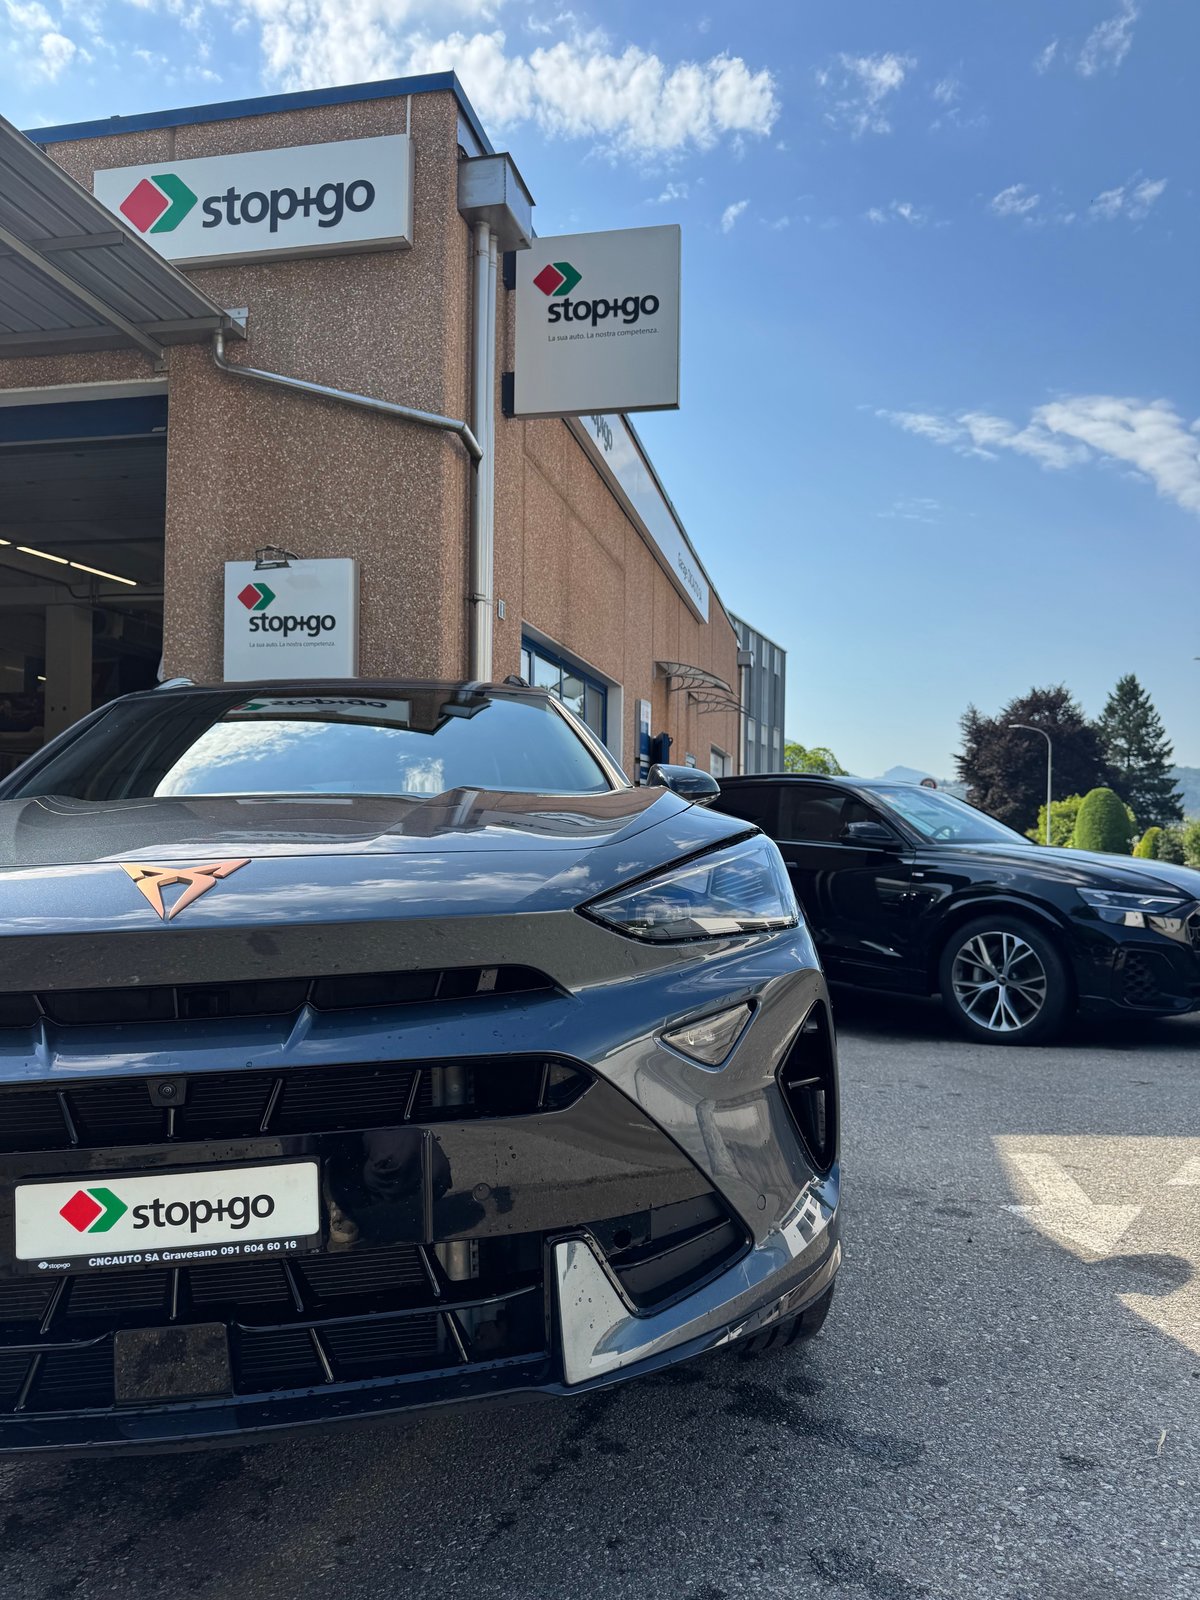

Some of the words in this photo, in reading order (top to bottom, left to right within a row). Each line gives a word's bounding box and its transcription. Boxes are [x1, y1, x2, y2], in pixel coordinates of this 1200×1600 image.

[202, 179, 376, 233] stop+go
[547, 294, 660, 326] stop+go
[595, 330, 615, 338] nostra
[617, 327, 659, 336] competenza.
[249, 612, 336, 638] stop+go
[132, 1194, 275, 1233] stop+go
[48, 1262, 71, 1270] stop+go
[88, 1254, 142, 1267] CNCAUTO
[144, 1252, 160, 1262] SA
[162, 1248, 218, 1261] Gravesano
[220, 1245, 240, 1255] 091
[243, 1243, 264, 1253] 604
[267, 1242, 280, 1251] 60
[284, 1240, 297, 1249] 16
